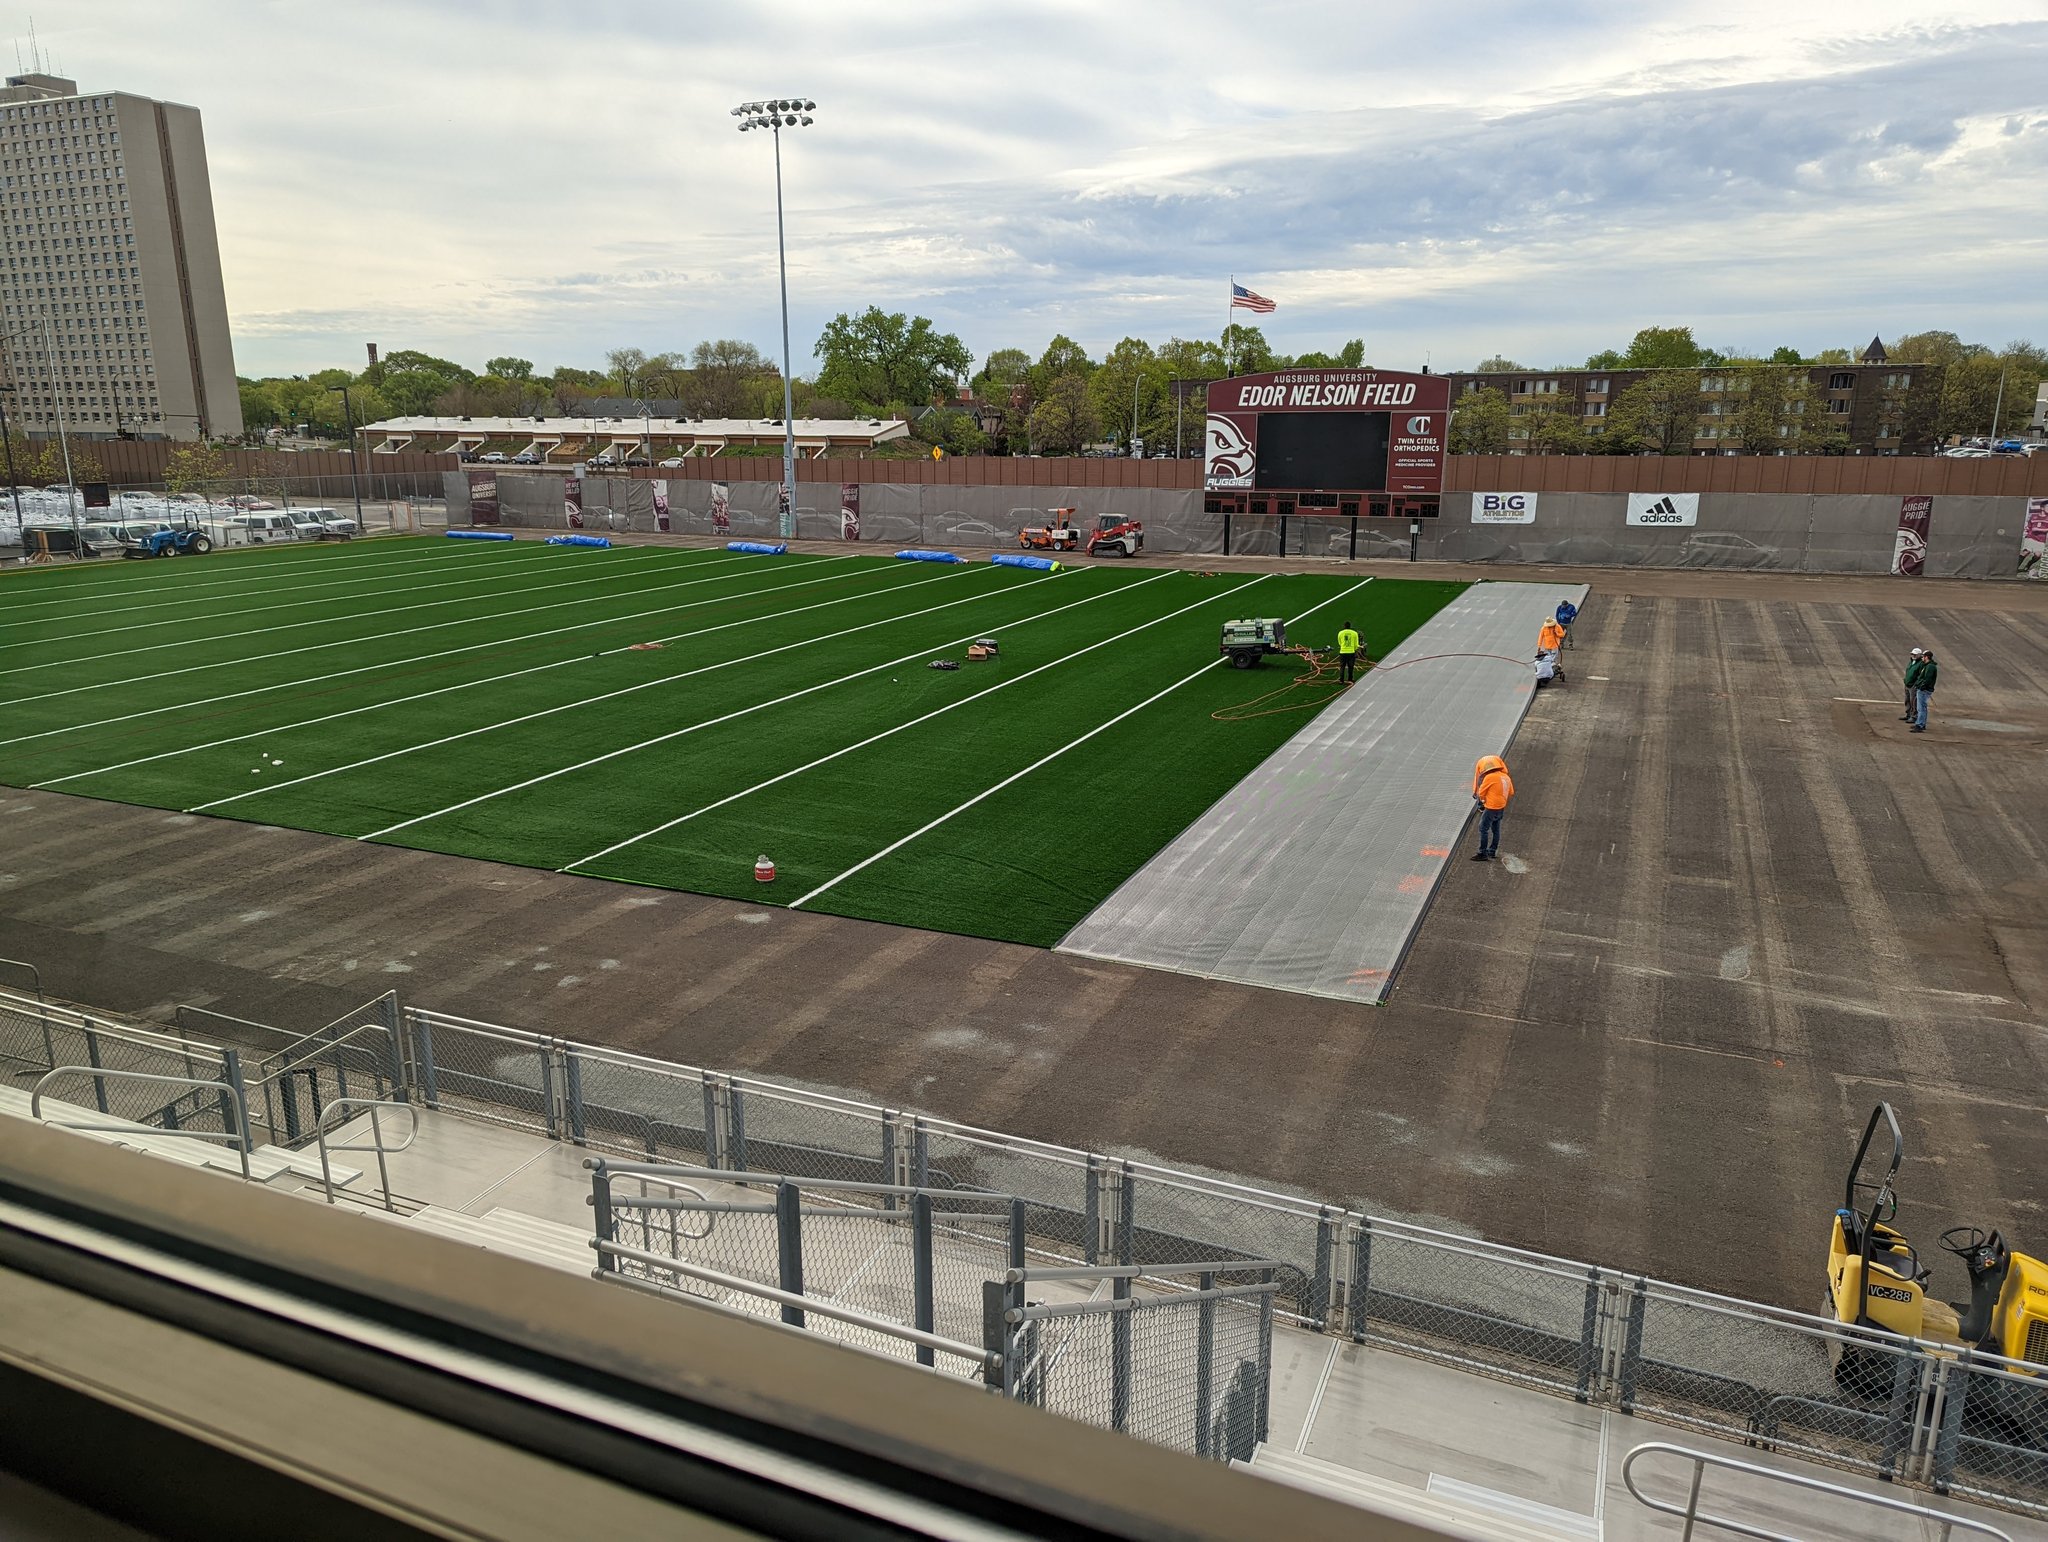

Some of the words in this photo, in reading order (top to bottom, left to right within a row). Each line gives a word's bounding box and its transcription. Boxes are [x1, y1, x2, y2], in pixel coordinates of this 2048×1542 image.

[1273, 374, 1320, 384] AUGSBURG
[1323, 373, 1377, 383] UNIVERSITY
[1238, 385, 1287, 407] EDOR
[1289, 384, 1360, 406] NELSON
[1362, 383, 1416, 405] FIELD
[472, 482, 496, 492] AUGSBURG
[1206, 478, 1253, 487] AUGGIES
[472, 490, 496, 499] UNIVERSITY
[1902, 501, 1931, 512] AUGGIE
[1640, 512, 1683, 523] adidas
[1904, 510, 1929, 520] PRIDE
[1870, 1285, 1911, 1302] VC-288
